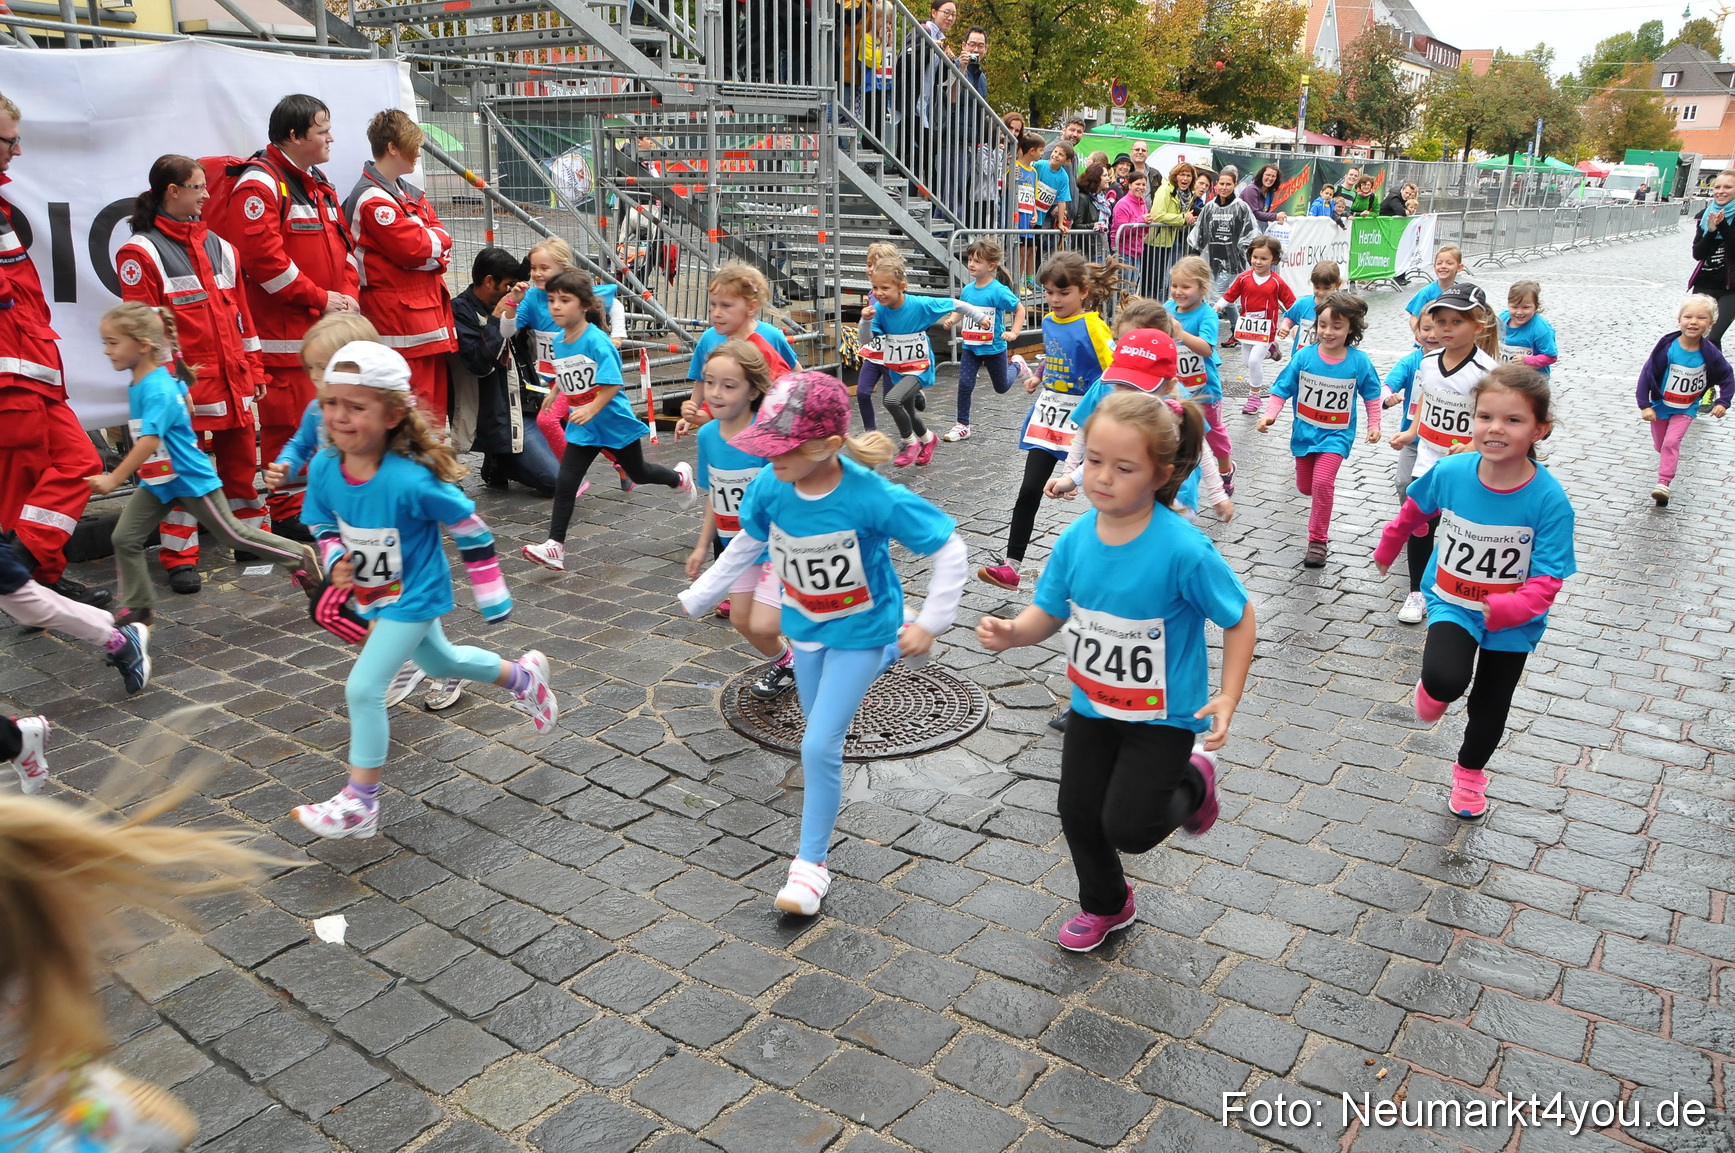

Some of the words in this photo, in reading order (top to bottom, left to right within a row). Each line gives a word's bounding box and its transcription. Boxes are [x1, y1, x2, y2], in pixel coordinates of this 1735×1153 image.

[1359, 229, 1382, 245] Herzlich
[1282, 246, 1305, 268] Audi
[1307, 245, 1327, 266] BKK
[1239, 318, 1267, 333] 7014
[888, 343, 925, 361] 7178
[1120, 345, 1157, 361] sophia
[1179, 355, 1201, 375] 02
[1319, 381, 1347, 390] Neumarkt
[1671, 374, 1704, 393] 7085
[1303, 384, 1349, 410] 7128
[1436, 396, 1467, 409] Neumarkt
[1315, 411, 1328, 422] Eva
[1424, 400, 1471, 433] 7556
[1465, 530, 1515, 544] Neumarkt
[352, 549, 392, 582] 24
[1444, 533, 1520, 579] 7242
[775, 546, 855, 590] 7152
[1455, 581, 1489, 601] Katja
[1088, 620, 1143, 640] Neumarkt
[1068, 628, 1153, 684] 7246
